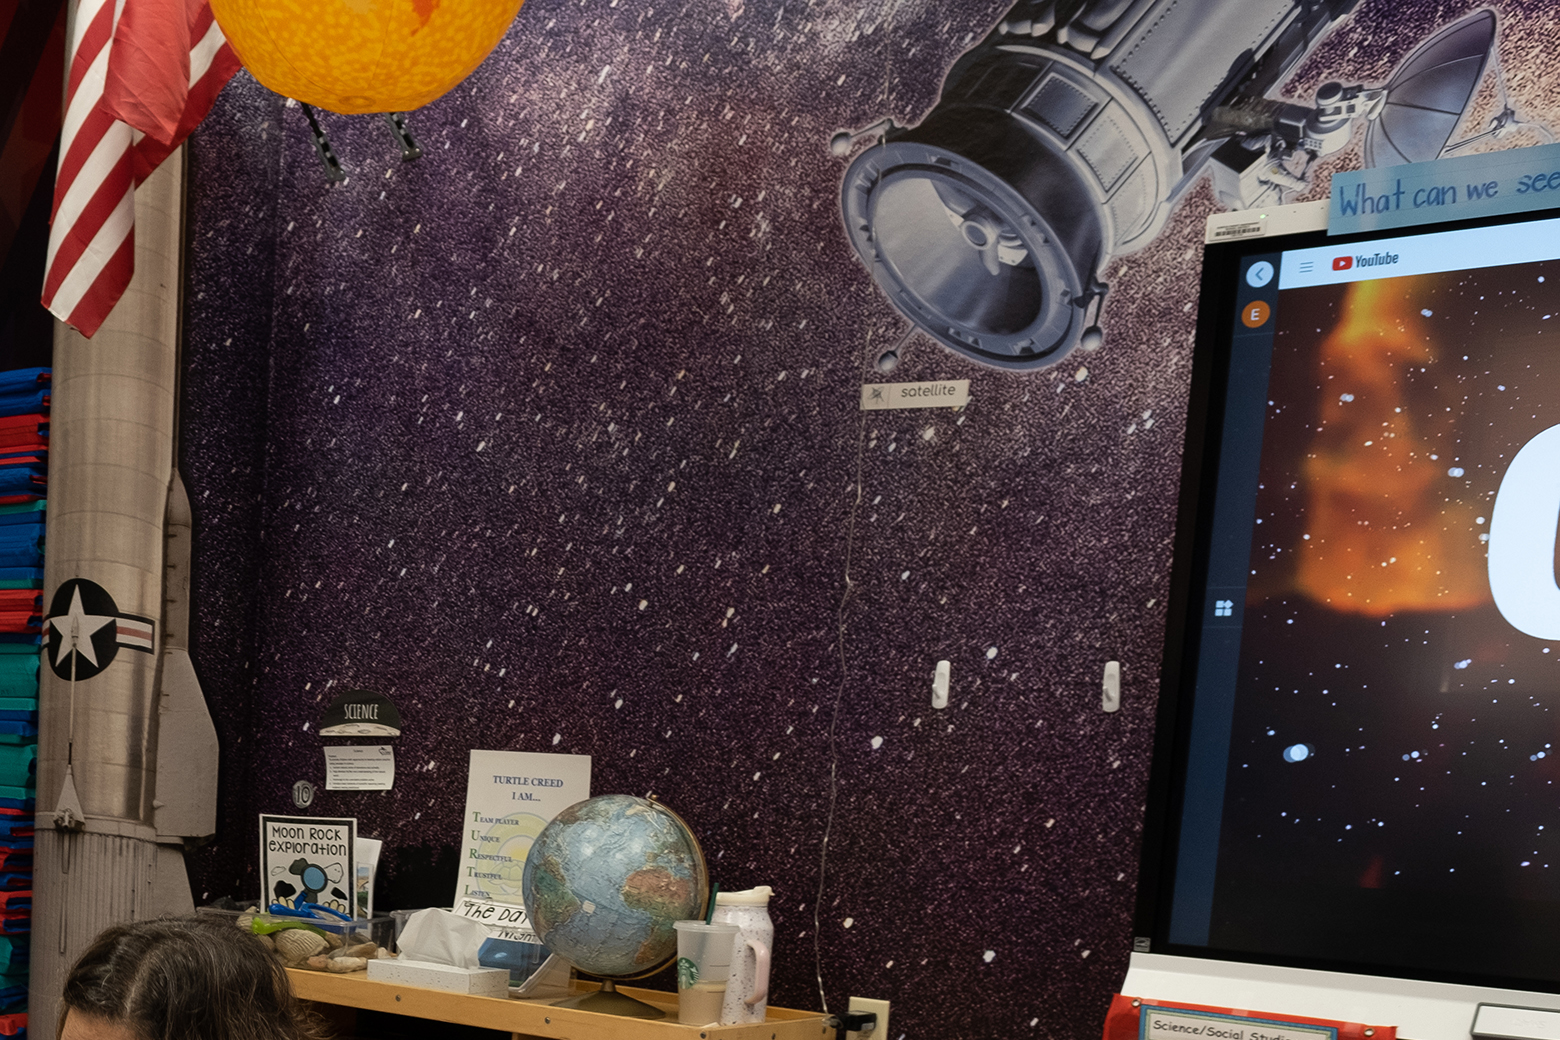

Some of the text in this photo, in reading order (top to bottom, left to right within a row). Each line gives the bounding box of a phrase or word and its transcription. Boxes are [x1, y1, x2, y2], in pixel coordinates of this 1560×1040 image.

[1340, 171, 1560, 217] What can we see
[1355, 252, 1400, 269] YouTube
[1250, 308, 1261, 322] E
[900, 383, 957, 398] satellite
[343, 703, 379, 720] SCIENCE
[492, 774, 564, 788] TURTLE CREED
[296, 785, 311, 804] 10
[511, 792, 516, 800] I
[268, 840, 347, 857] exploration
[464, 901, 495, 919] The
